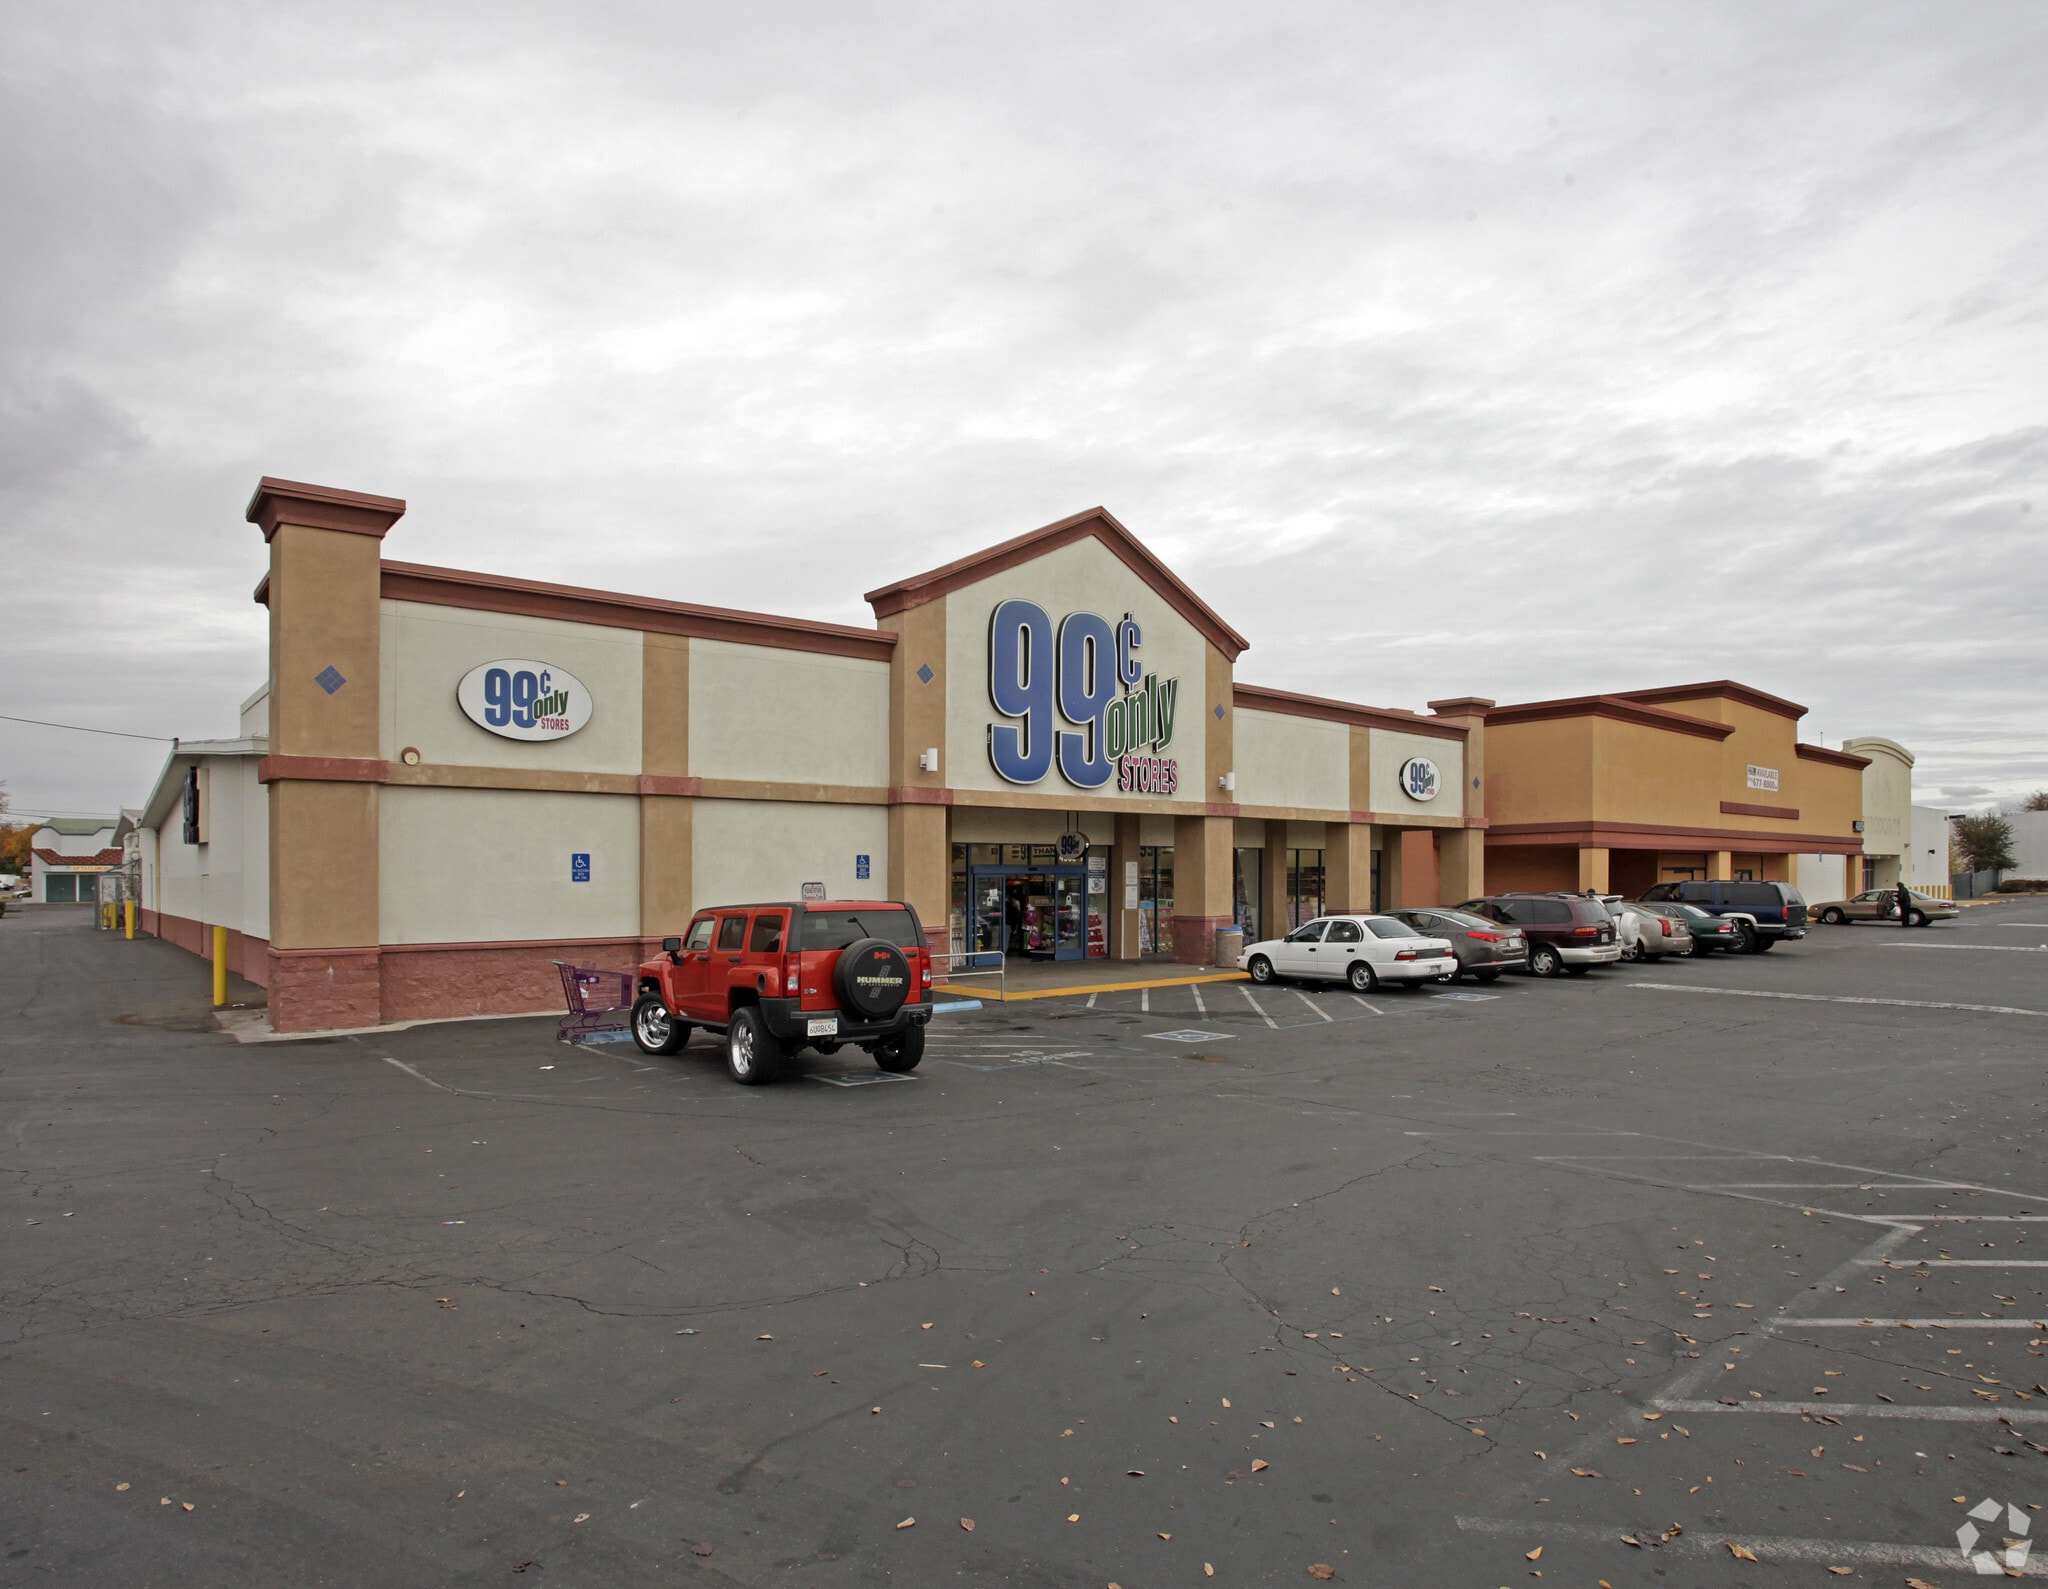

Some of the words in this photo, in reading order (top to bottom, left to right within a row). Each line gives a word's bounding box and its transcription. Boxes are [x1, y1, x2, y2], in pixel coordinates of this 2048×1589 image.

[533, 689, 569, 719] only
[1104, 672, 1179, 762] only
[541, 717, 570, 731] STORES
[1118, 754, 1178, 794] STORES
[857, 976, 903, 984] HUMMER
